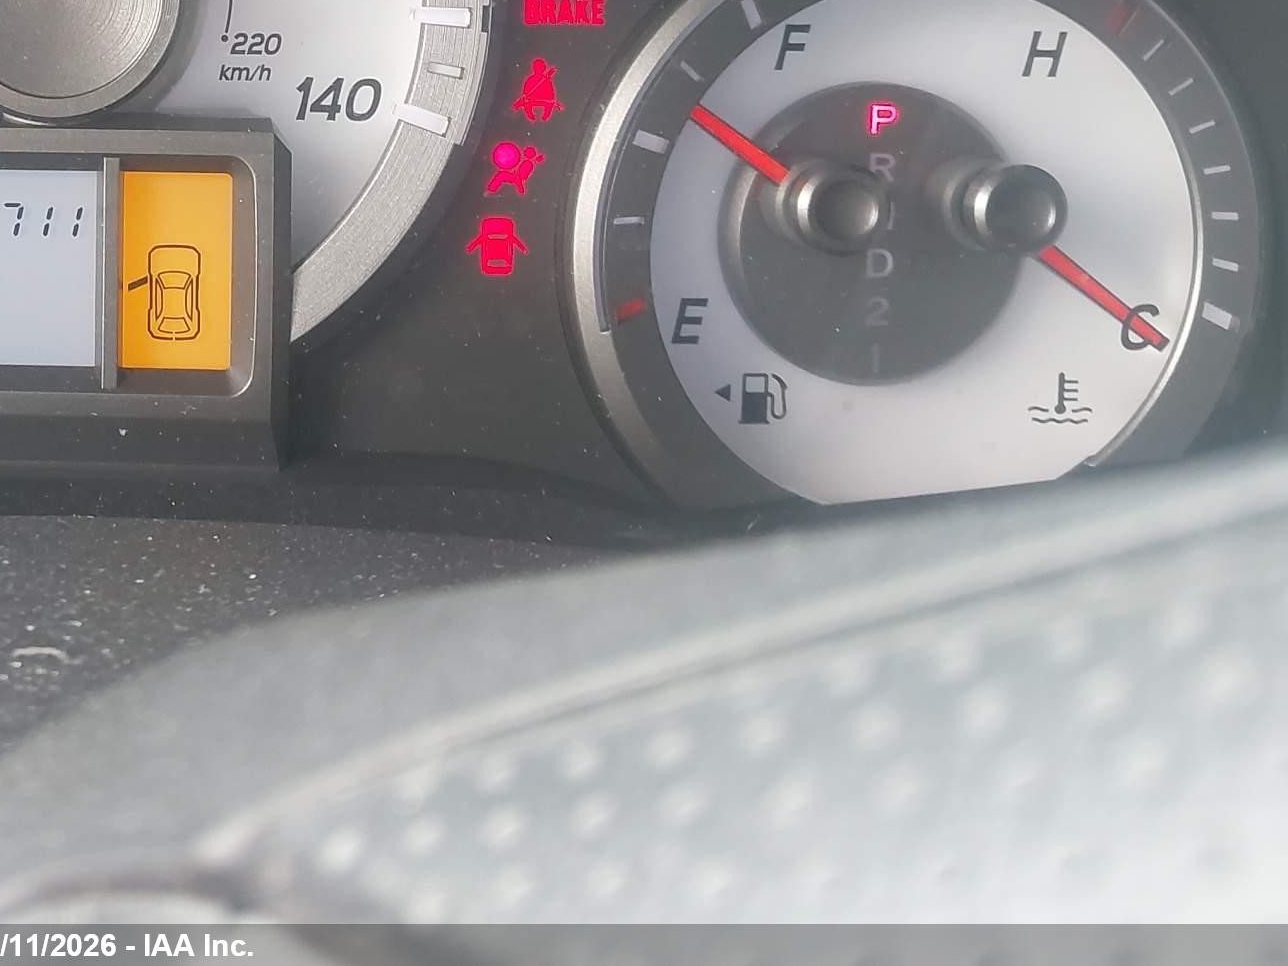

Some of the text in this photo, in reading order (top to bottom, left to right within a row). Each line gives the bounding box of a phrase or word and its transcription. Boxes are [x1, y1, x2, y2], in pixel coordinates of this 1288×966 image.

[230, 33, 281, 55] 220
[775, 24, 811, 70] F
[1022, 31, 1067, 77] H
[219, 64, 271, 82] km/h
[296, 77, 381, 121] 140
[869, 104, 897, 135] P
[869, 152, 897, 182] R
[866, 248, 894, 278] D
[671, 298, 709, 344] E
[1120, 304, 1160, 351] C
